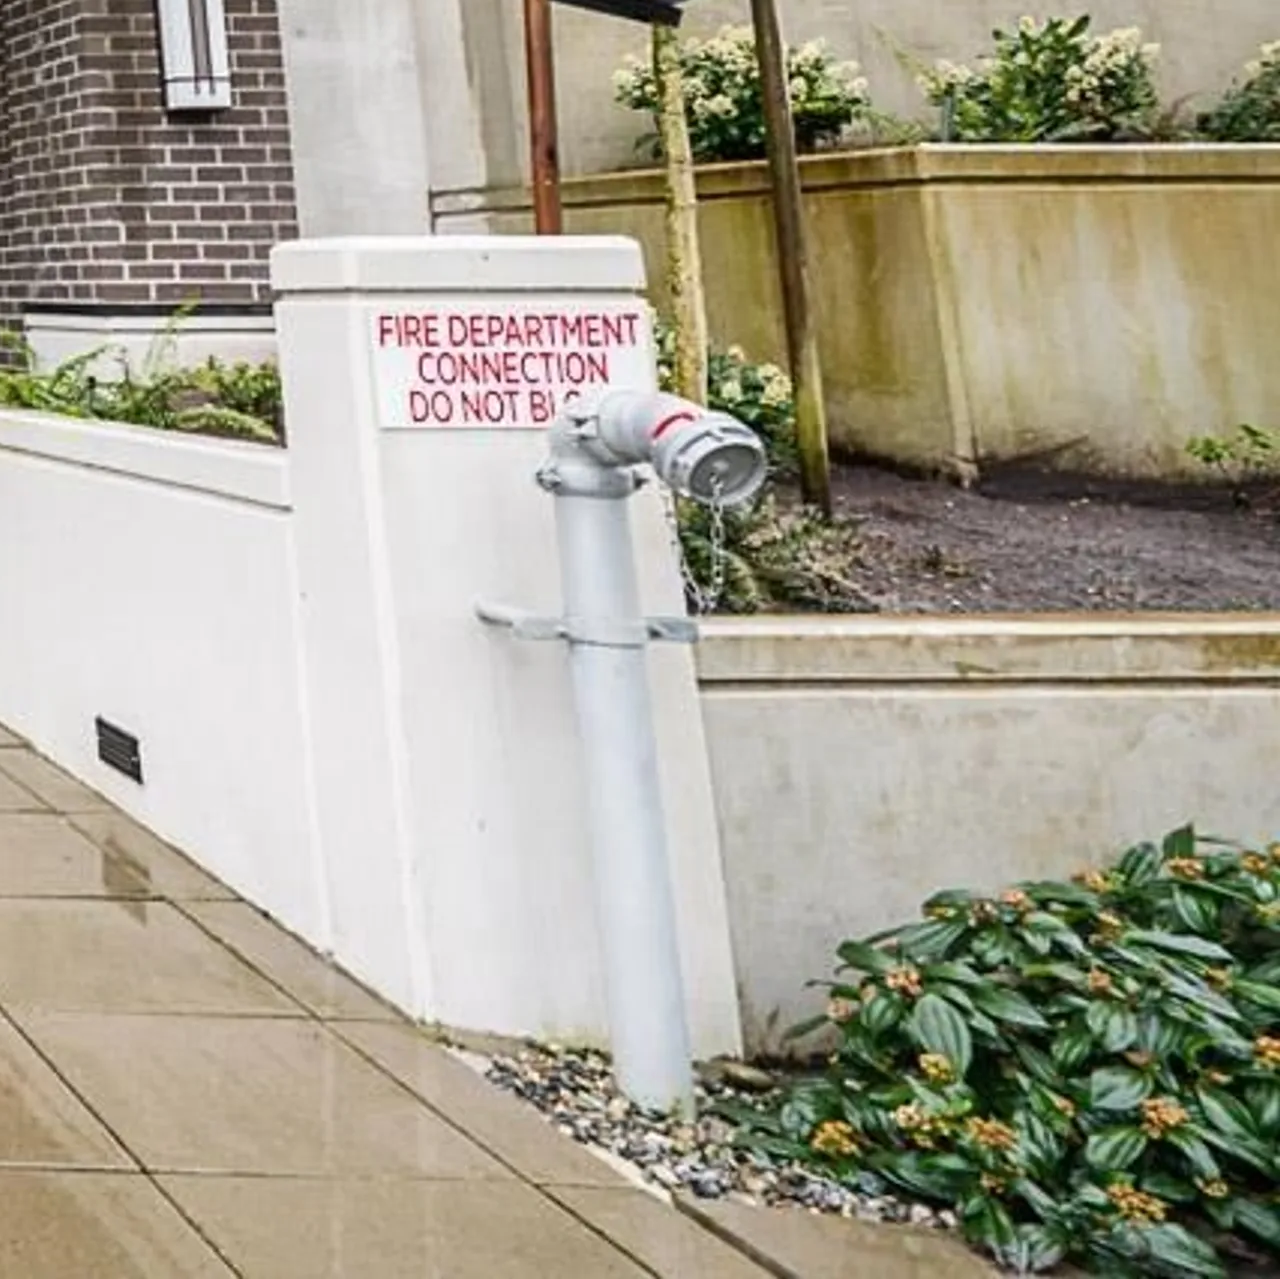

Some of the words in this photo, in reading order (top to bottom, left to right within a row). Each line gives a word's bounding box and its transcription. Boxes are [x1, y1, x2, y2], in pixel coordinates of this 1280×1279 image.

[378, 314, 440, 347] FIRE
[447, 314, 639, 347] DEPARTMENT
[417, 351, 610, 384] CONNECTION
[409, 390, 454, 423] DO
[460, 390, 520, 423] NOT
